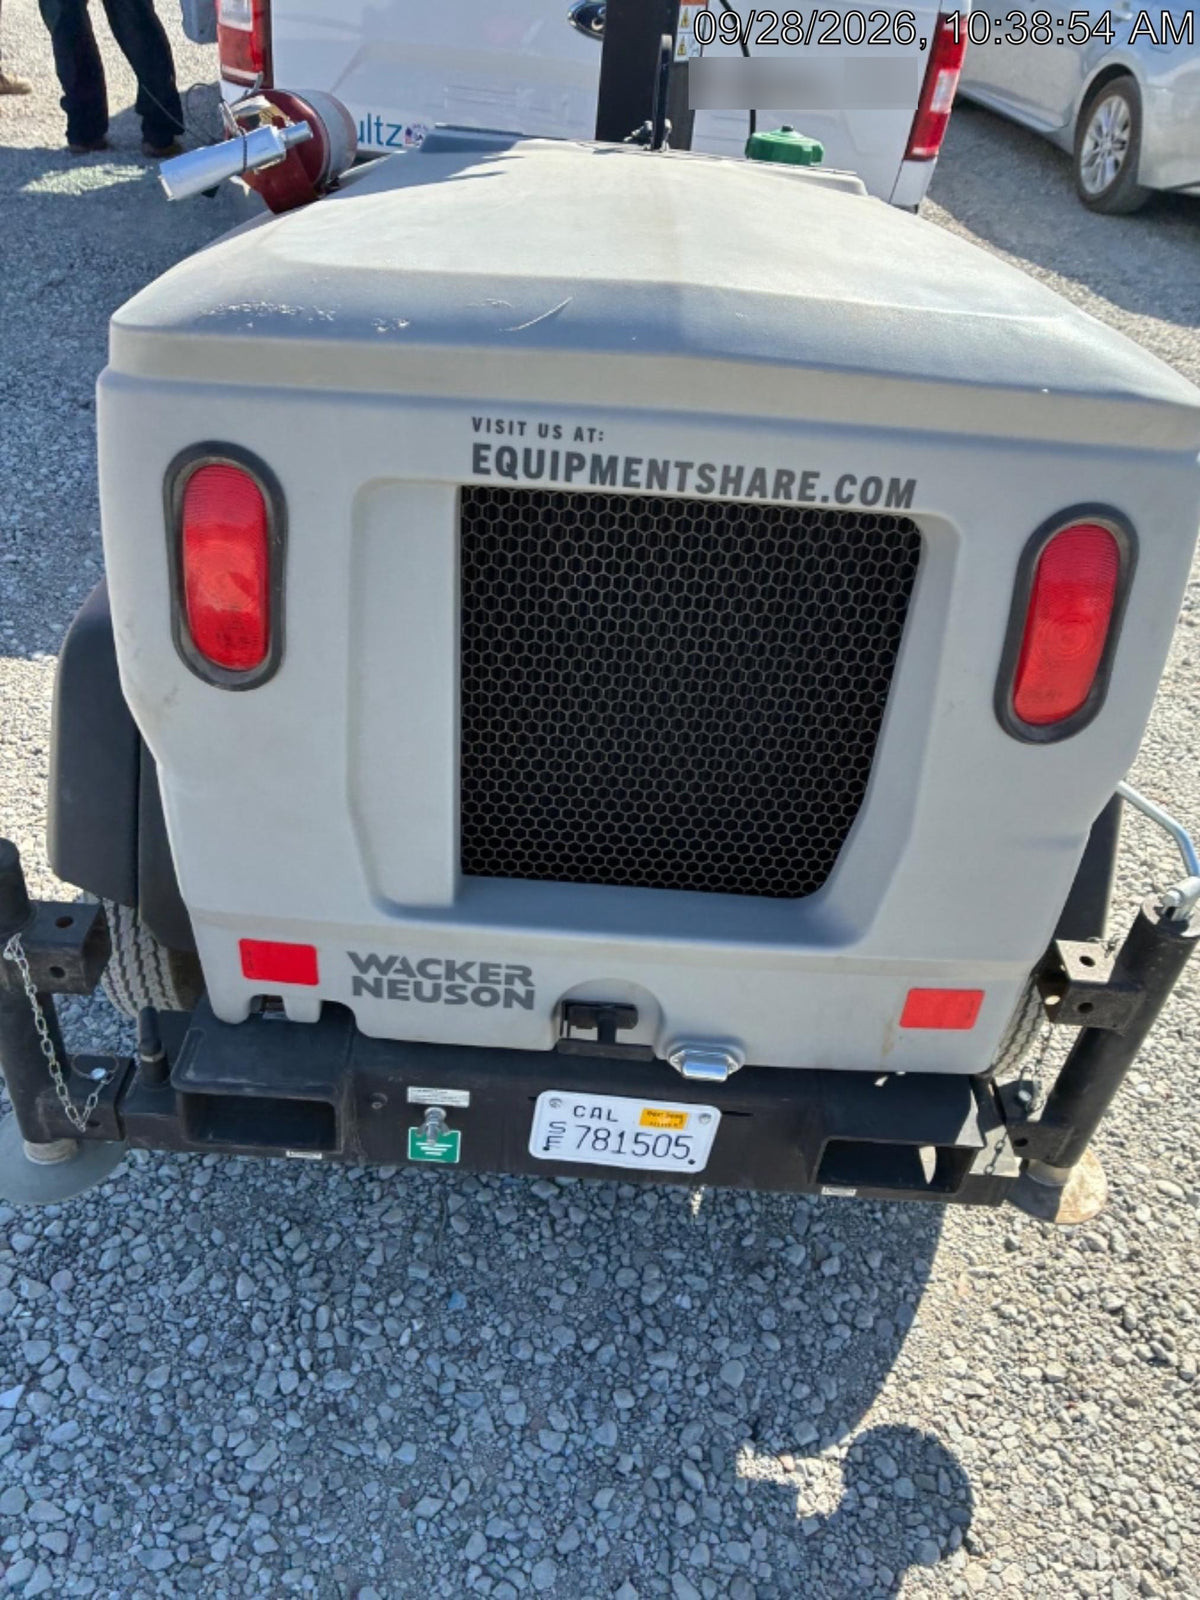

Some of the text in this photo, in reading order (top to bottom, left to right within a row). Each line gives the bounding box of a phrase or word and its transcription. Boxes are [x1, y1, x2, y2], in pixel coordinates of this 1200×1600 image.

[471, 416, 604, 442] VISIT US AT:
[472, 442, 917, 510] EQUIPMENTSHARE.COM
[346, 951, 535, 987] WACKER
[352, 975, 535, 1010] NEUSON
[573, 1105, 619, 1122] CAL
[574, 1124, 693, 1160] 781505
